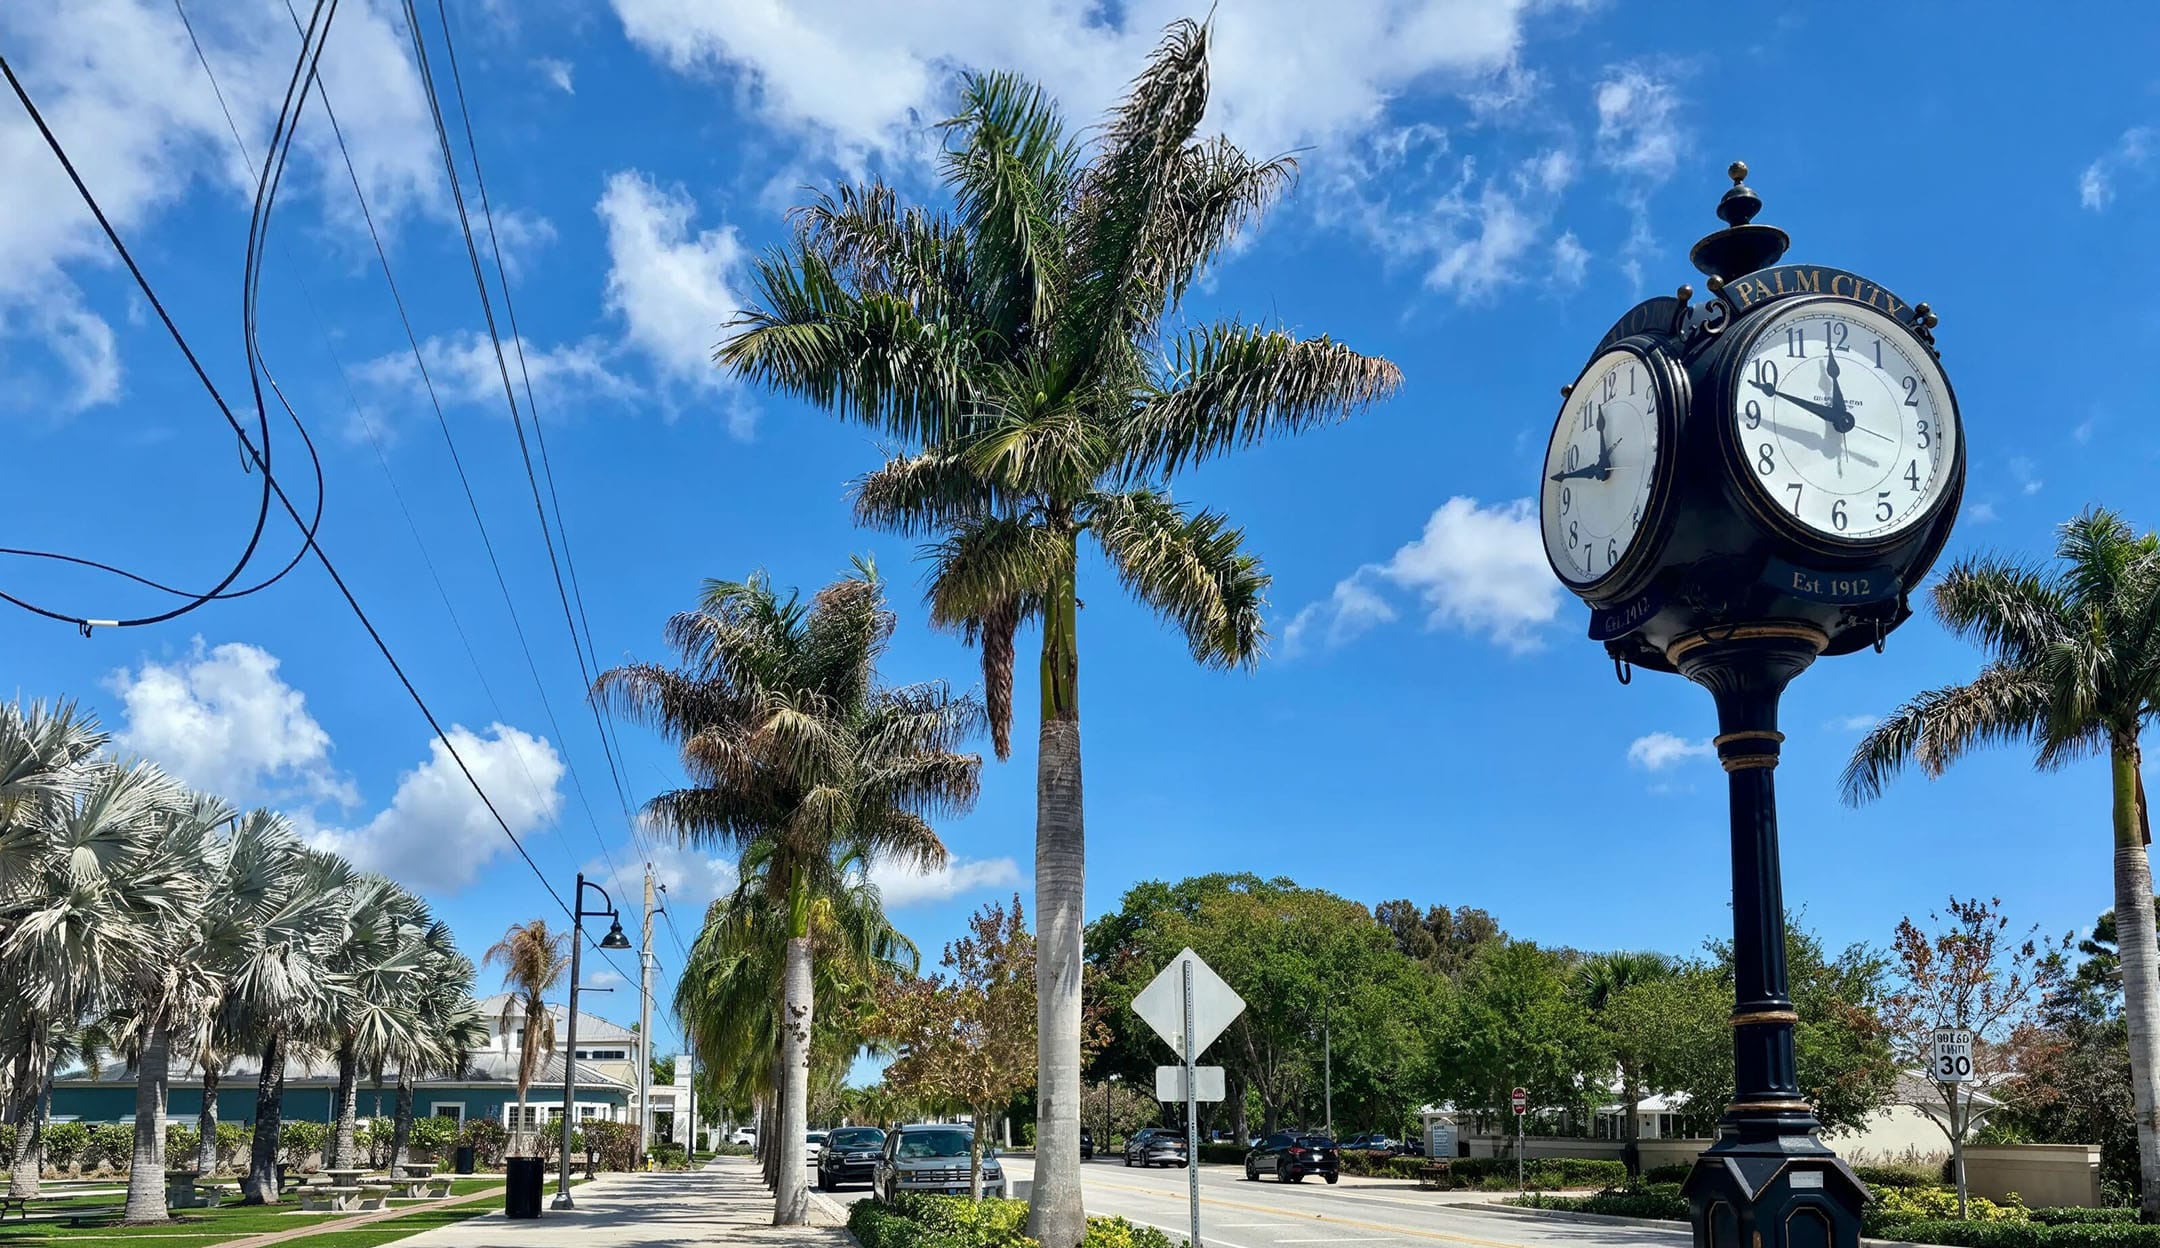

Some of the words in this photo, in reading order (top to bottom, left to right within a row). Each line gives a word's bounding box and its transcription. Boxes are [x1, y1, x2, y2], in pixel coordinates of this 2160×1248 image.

[1735, 270, 1821, 308] PALM
[1831, 274, 1904, 316] CITY
[1786, 327, 1807, 358] 11
[1824, 321, 1850, 351] 12
[1872, 339, 1884, 369] 1
[1601, 371, 1617, 405] 12
[1629, 366, 1635, 396] 1
[1752, 358, 1778, 391] 10
[1646, 384, 1655, 415] 2
[1902, 376, 1919, 407] 2
[1582, 400, 1594, 432] 11
[1745, 400, 1761, 430] 9
[1916, 420, 1930, 449] 3
[1568, 444, 1579, 473] 10
[1758, 443, 1775, 475] 8
[1904, 459, 1920, 491] 4
[1562, 487, 1571, 515] 9
[1787, 483, 1803, 518] 7
[1831, 499, 1848, 531] 6
[1875, 491, 1893, 522] 5
[1569, 521, 1578, 549] 8
[1584, 543, 1592, 572] 7
[1608, 538, 1618, 567] 6
[1792, 571, 1823, 594] Est.
[1831, 579, 1871, 596] 1912
[1940, 1056, 1970, 1075] 30
